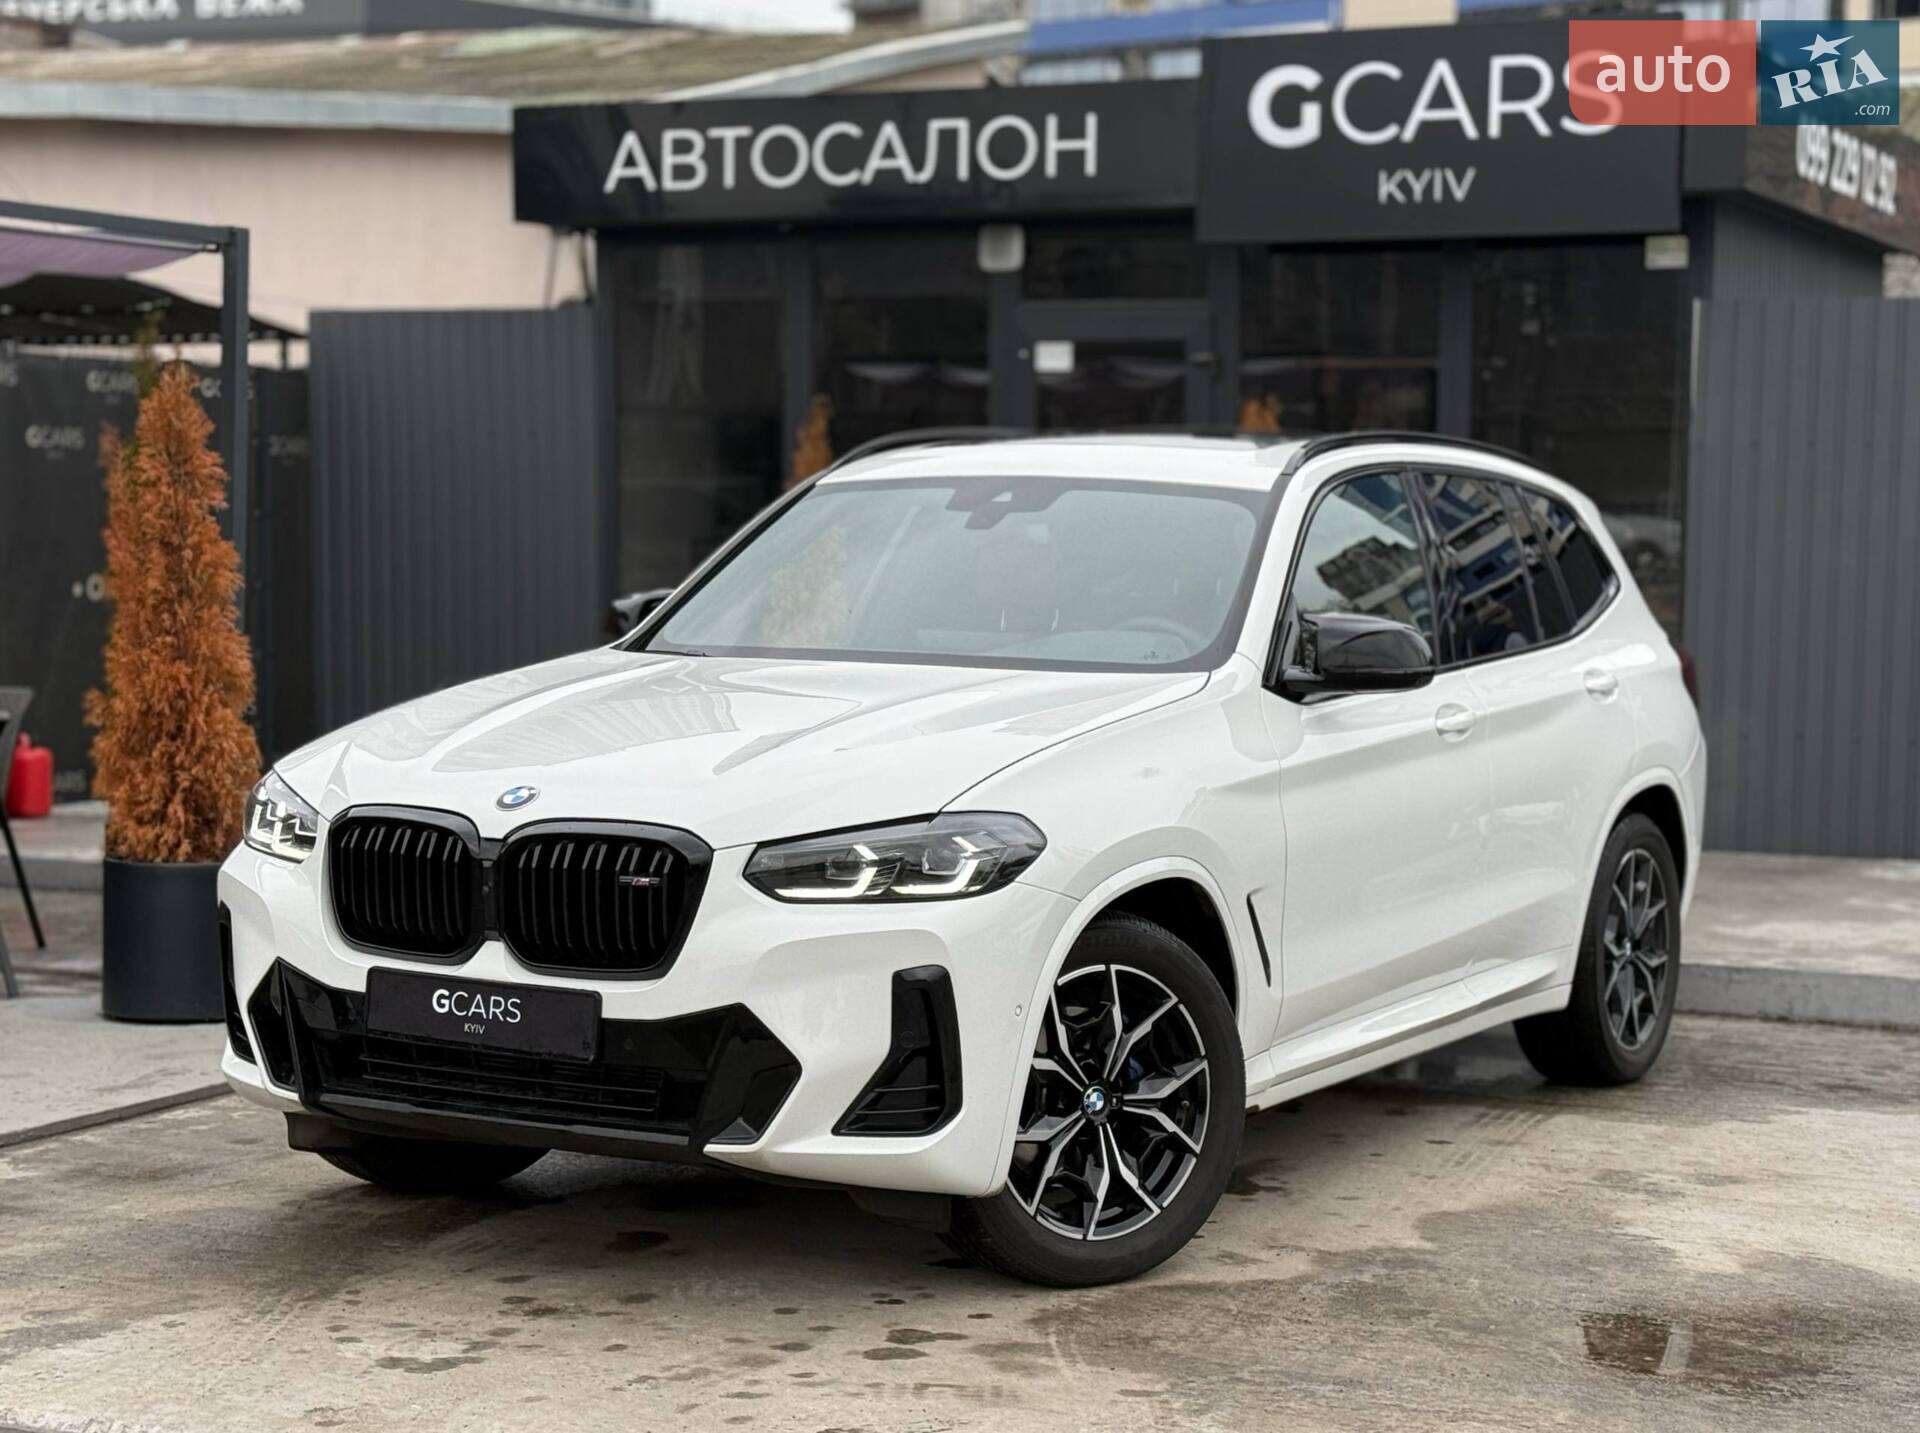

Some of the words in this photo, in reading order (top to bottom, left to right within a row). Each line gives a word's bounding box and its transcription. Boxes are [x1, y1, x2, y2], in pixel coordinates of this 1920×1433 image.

[1247, 49, 1623, 149] GCARS
[603, 111, 1098, 194] АВТОСАЛОН
[1377, 166, 1476, 205] KYIV
[432, 988, 522, 1023] GCARS
[463, 1022, 485, 1035] KYIV
